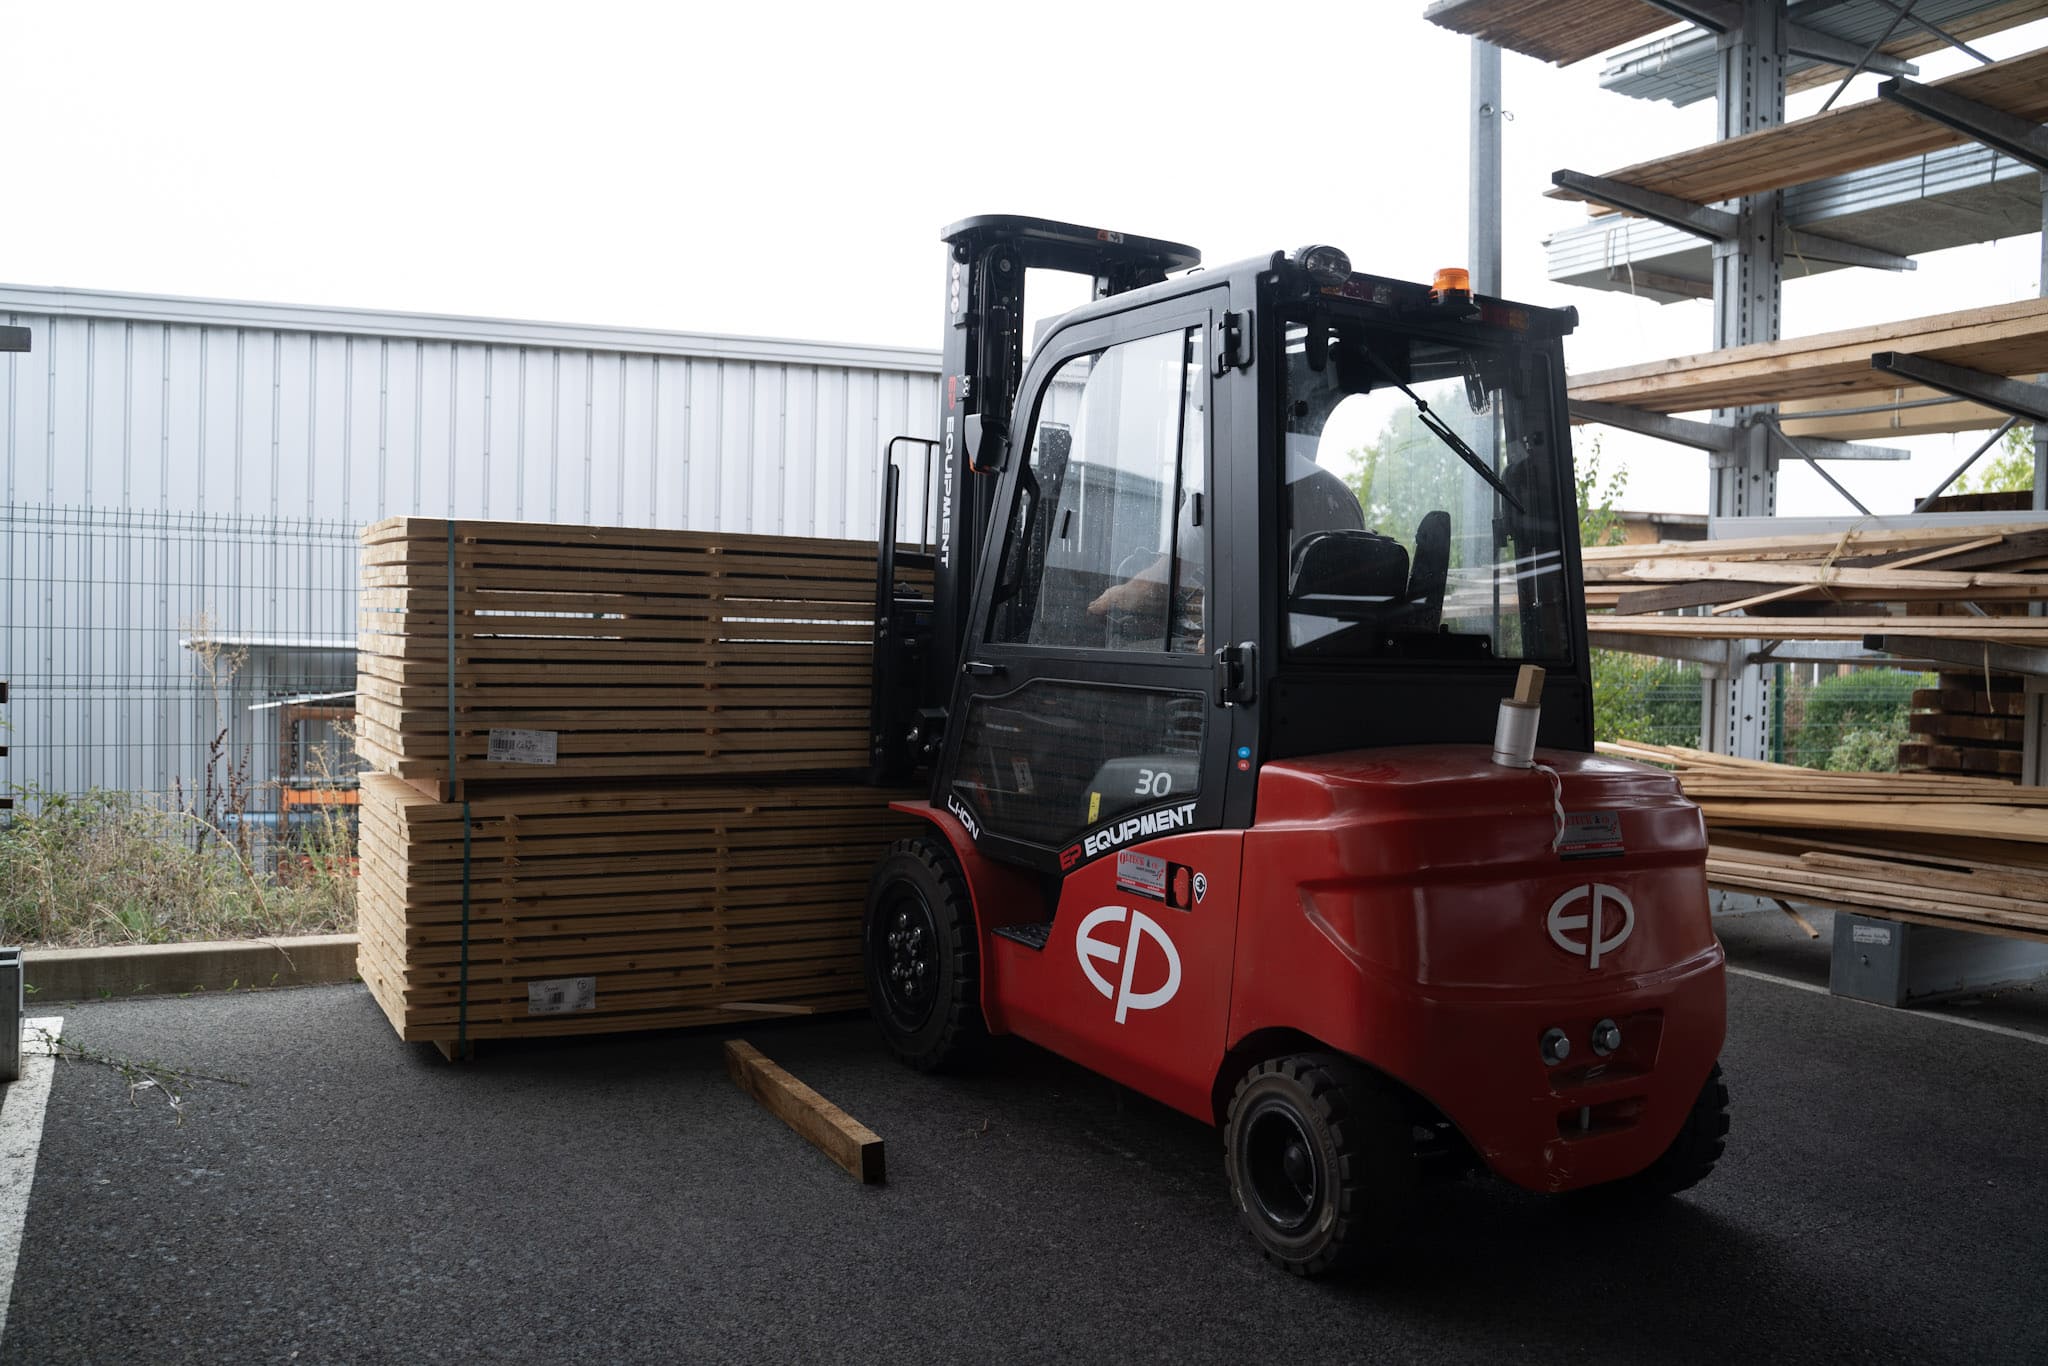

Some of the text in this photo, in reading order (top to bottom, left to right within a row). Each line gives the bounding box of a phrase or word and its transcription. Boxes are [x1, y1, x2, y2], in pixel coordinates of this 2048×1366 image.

[940, 416, 955, 568] EQUIPMENT
[1135, 769, 1172, 796] 30
[1058, 844, 1083, 872] EP
[1084, 803, 1197, 858] EQUIPMENT
[1076, 905, 1181, 1025] EP
[1547, 883, 1635, 969] EP
